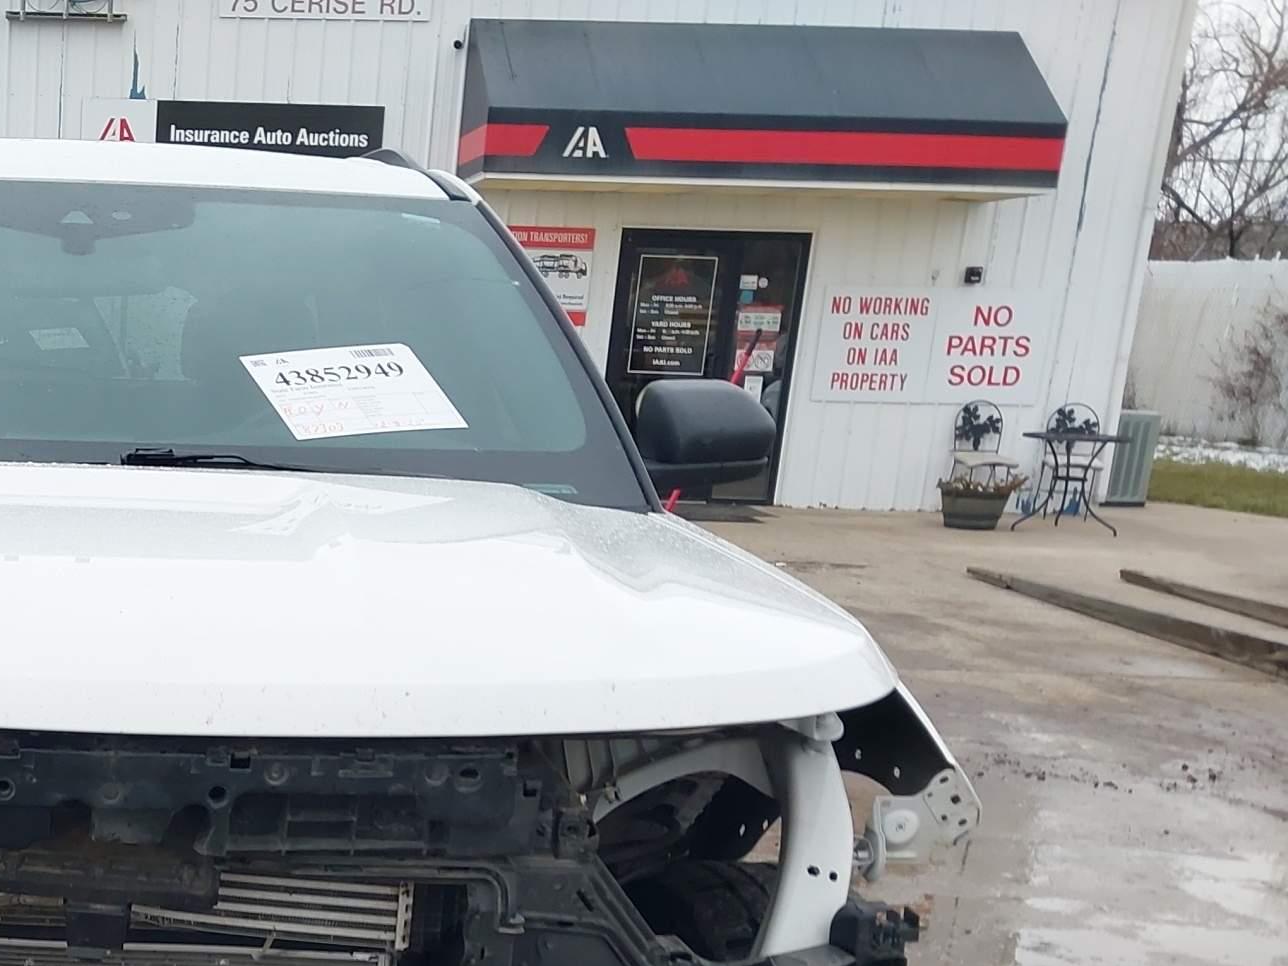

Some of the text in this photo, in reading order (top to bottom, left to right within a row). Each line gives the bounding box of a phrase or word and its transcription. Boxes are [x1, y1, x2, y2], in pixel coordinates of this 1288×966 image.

[272, 0, 366, 14] CERISE
[379, 0, 422, 15] RD.
[169, 124, 369, 148] Insurance Auto Auctions
[831, 296, 930, 316] NO WORKING
[973, 305, 1013, 327] NO
[843, 322, 910, 341] ON CARS
[643, 345, 653, 353] NO
[675, 346, 693, 354] SOLD
[946, 335, 1031, 357] PARTS
[847, 347, 898, 366] ON IAA
[275, 361, 404, 386] 43852949
[830, 372, 908, 391] PROPERTY
[948, 364, 1021, 386] SOLD
